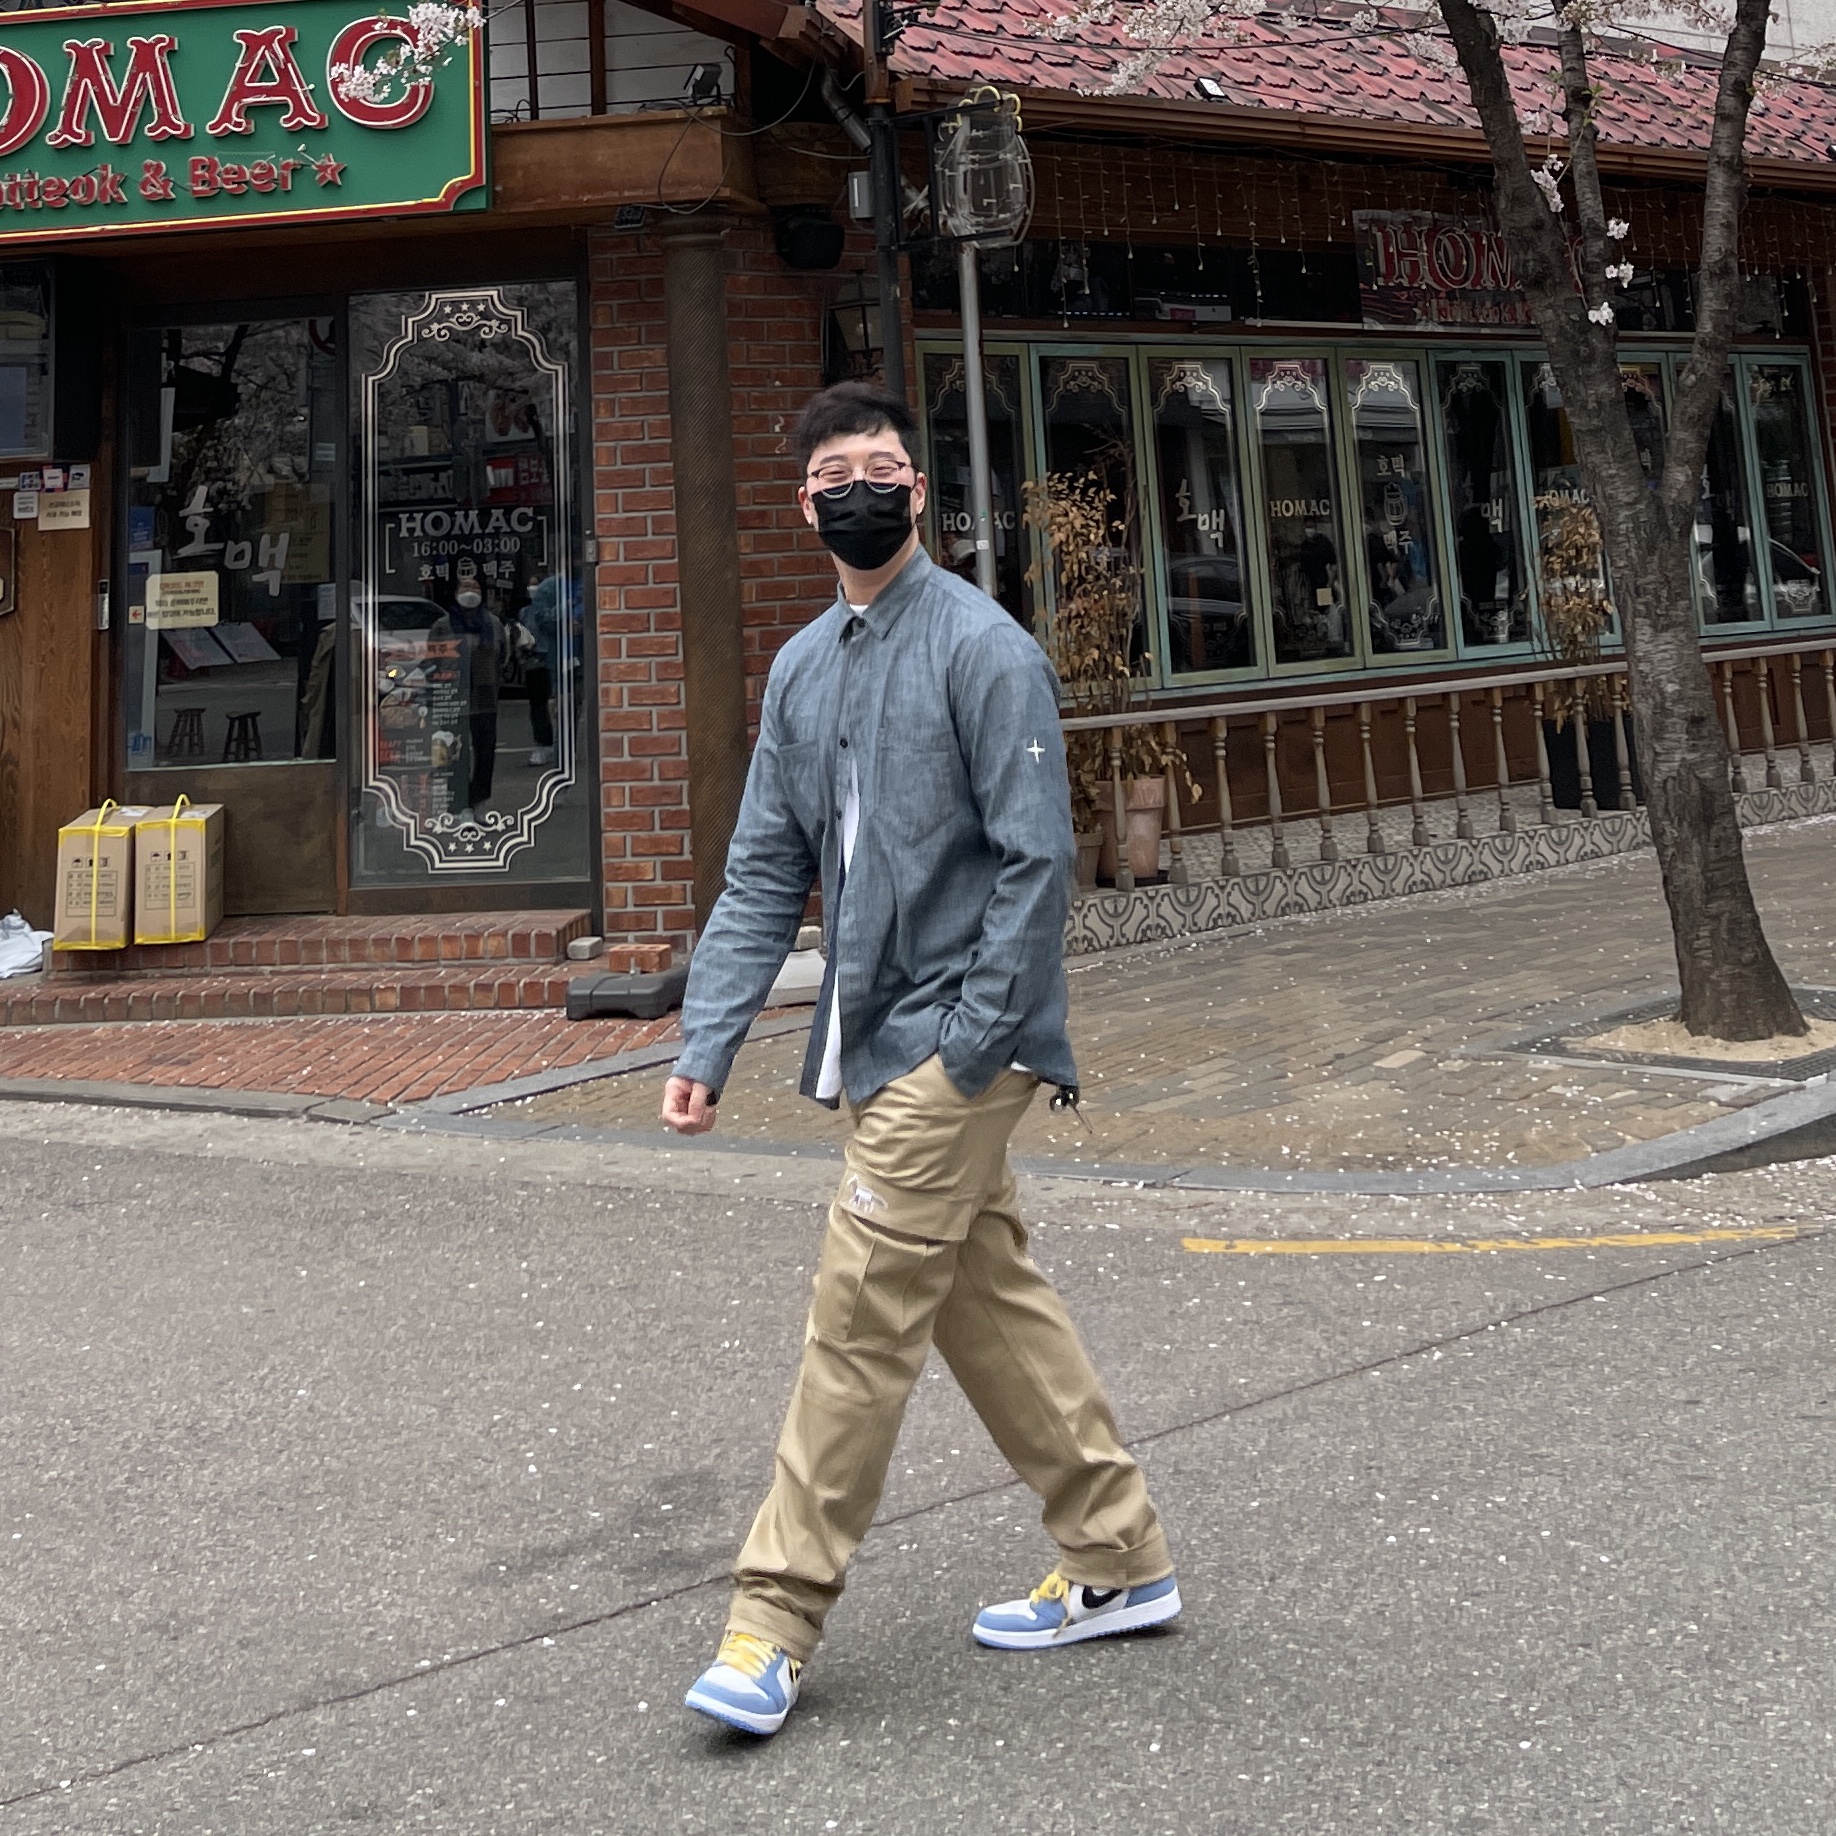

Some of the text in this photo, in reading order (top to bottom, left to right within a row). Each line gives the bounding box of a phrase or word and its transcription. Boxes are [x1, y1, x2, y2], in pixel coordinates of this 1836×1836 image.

[0, 155, 302, 211] tteok & Beer
[1546, 488, 1590, 507] OMAC
[1270, 499, 1331, 518] HOMAC
[398, 507, 534, 538] HOMAC
[412, 537, 521, 557] 16:00~03:00
